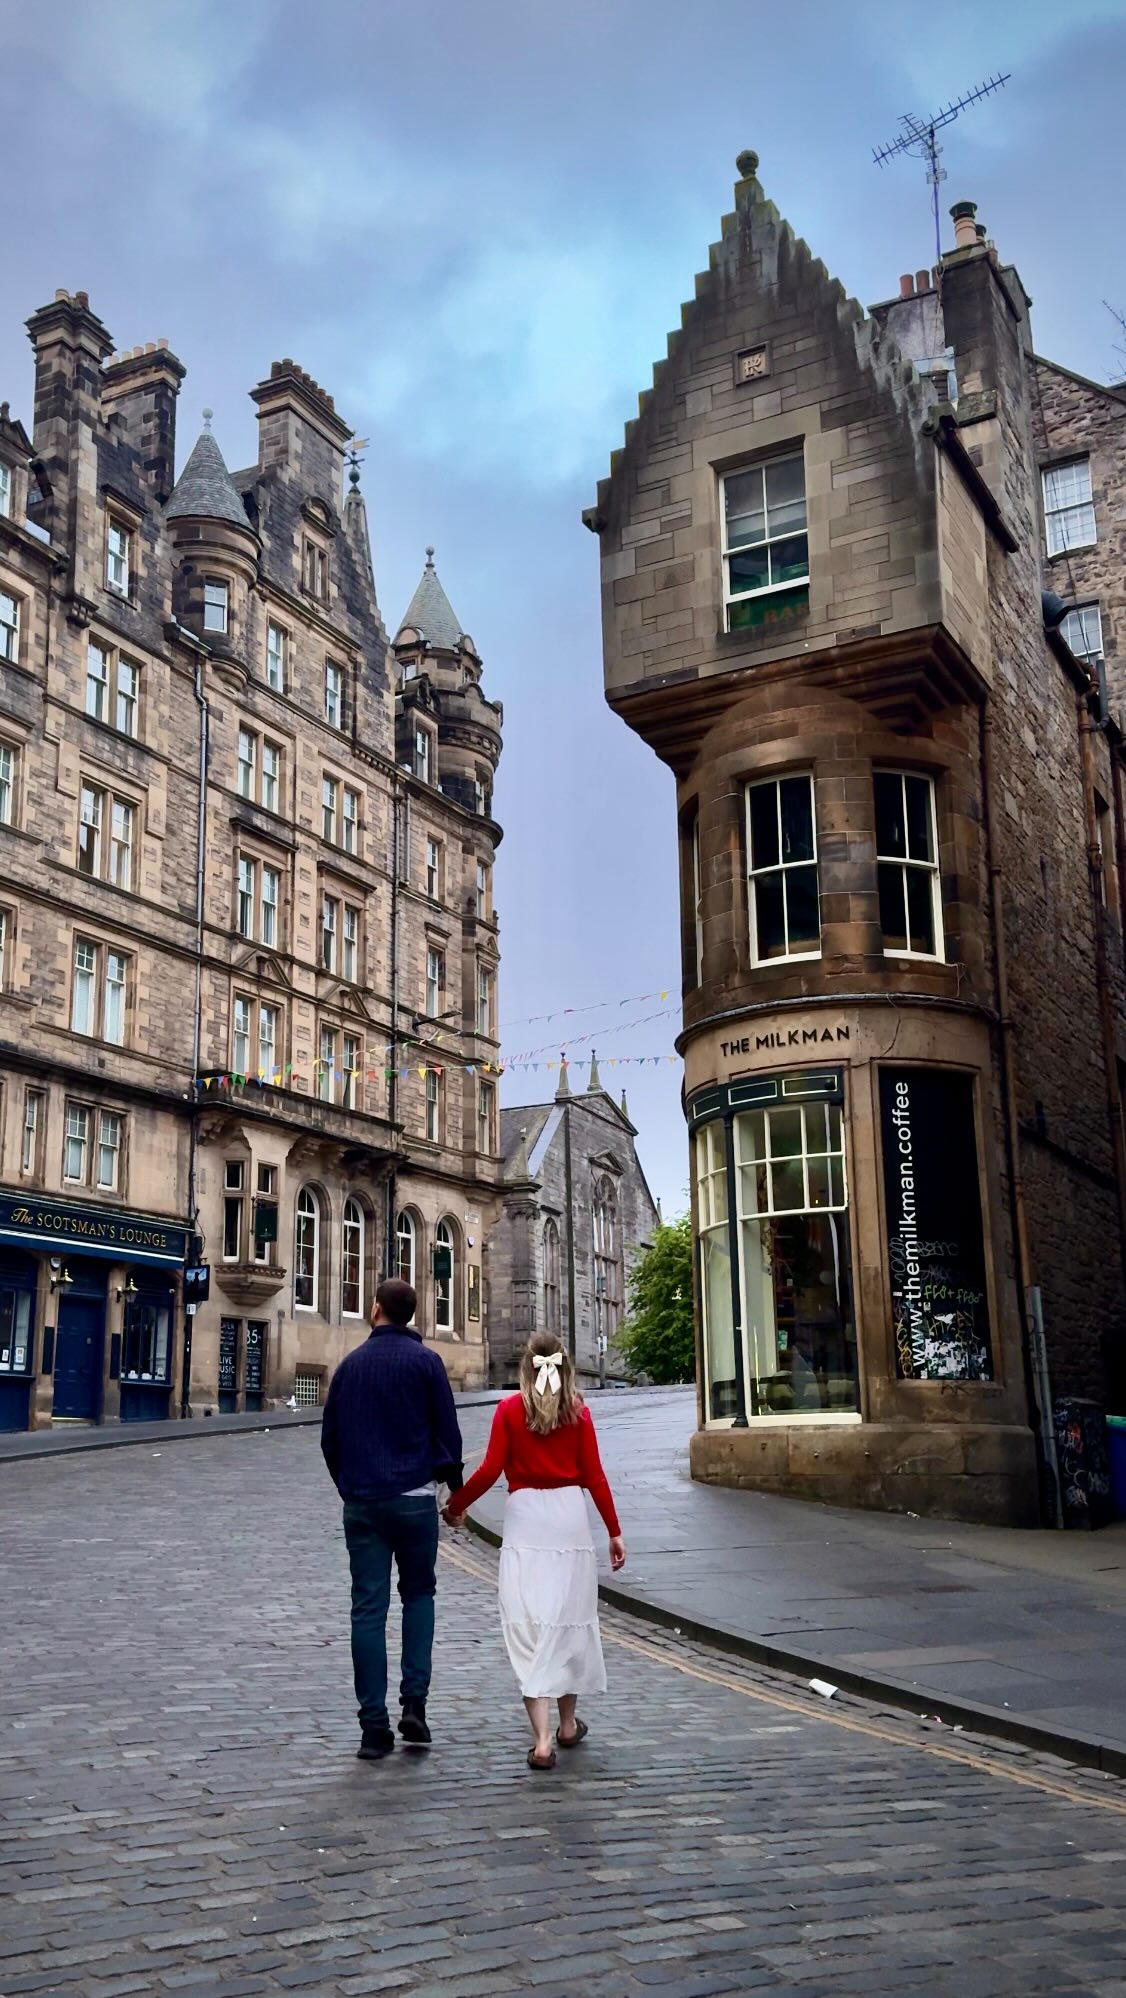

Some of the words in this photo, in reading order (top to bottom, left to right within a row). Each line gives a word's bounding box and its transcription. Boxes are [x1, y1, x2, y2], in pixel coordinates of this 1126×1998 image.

[720, 1038, 750, 1057] THE
[756, 1026, 850, 1050] MILKMAN
[10, 1208, 34, 1225] The
[37, 1212, 116, 1239] SCOTSMAN'S
[119, 1227, 167, 1248] LOUNGE
[892, 1082, 928, 1367] www.themilkman.coffee
[220, 1365, 235, 1374] USIC
